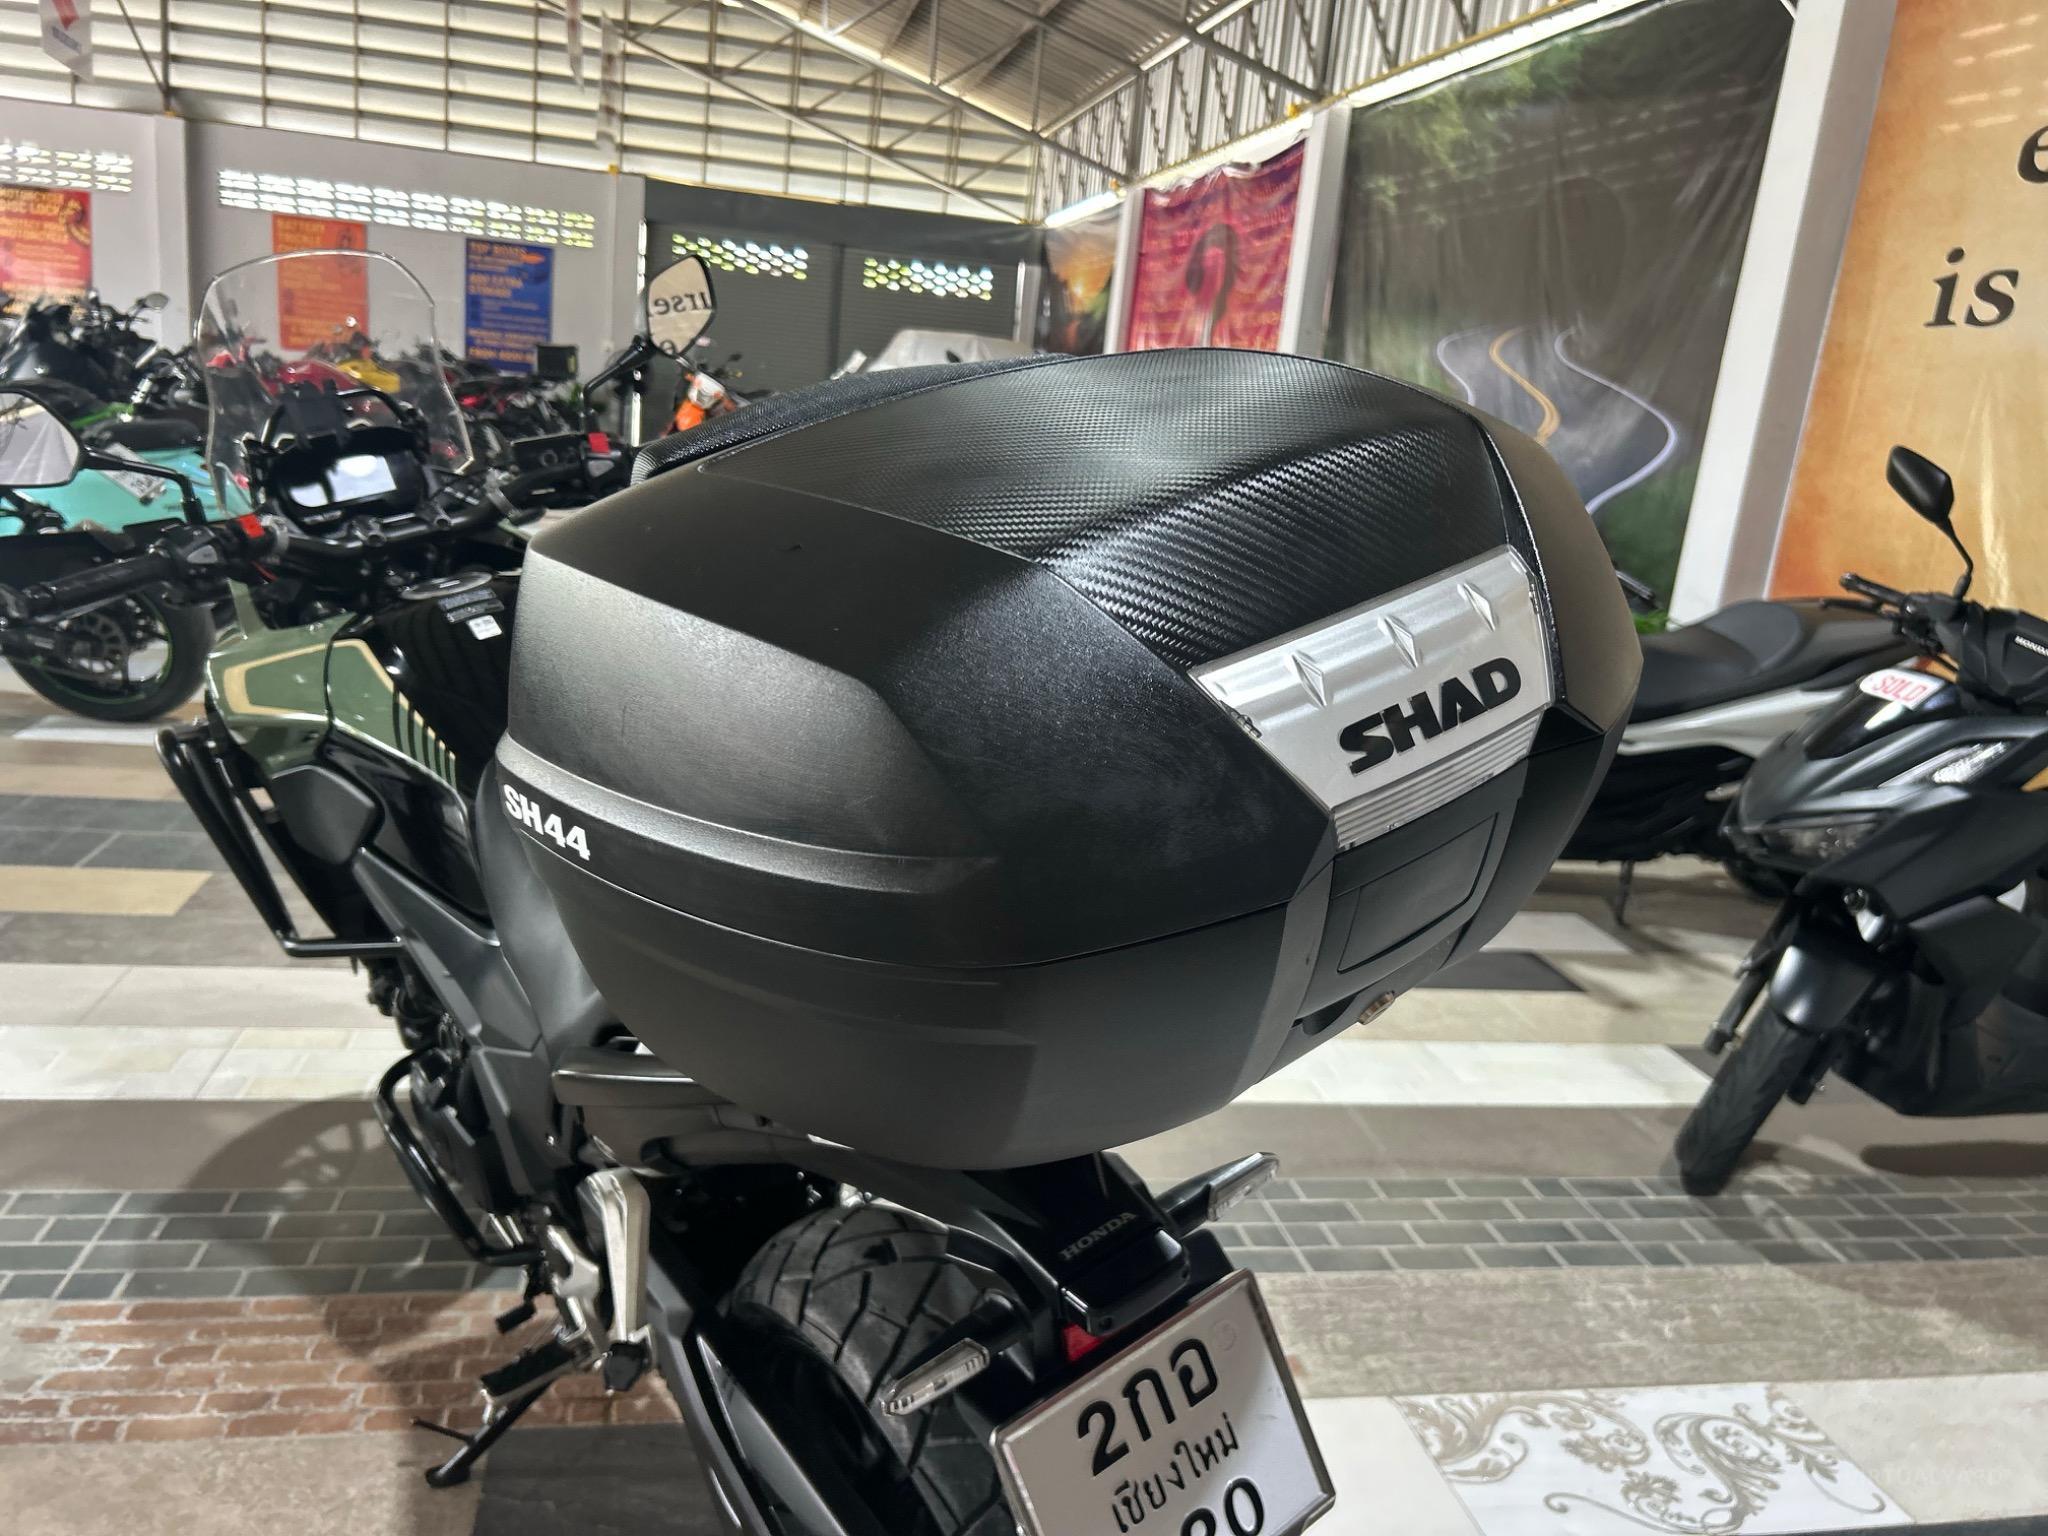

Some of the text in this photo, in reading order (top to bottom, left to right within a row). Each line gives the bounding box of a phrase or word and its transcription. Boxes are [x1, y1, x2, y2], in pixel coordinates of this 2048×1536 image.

[1922, 246, 2020, 328] is
[1338, 657, 1522, 777] SHAD
[1872, 674, 1929, 702] SOLD
[503, 783, 591, 861] SH44
[1060, 1211, 1138, 1260] HONDA
[1077, 1338, 1218, 1477] 2กอ
[1111, 1411, 1240, 1534] เชียงใหม่
